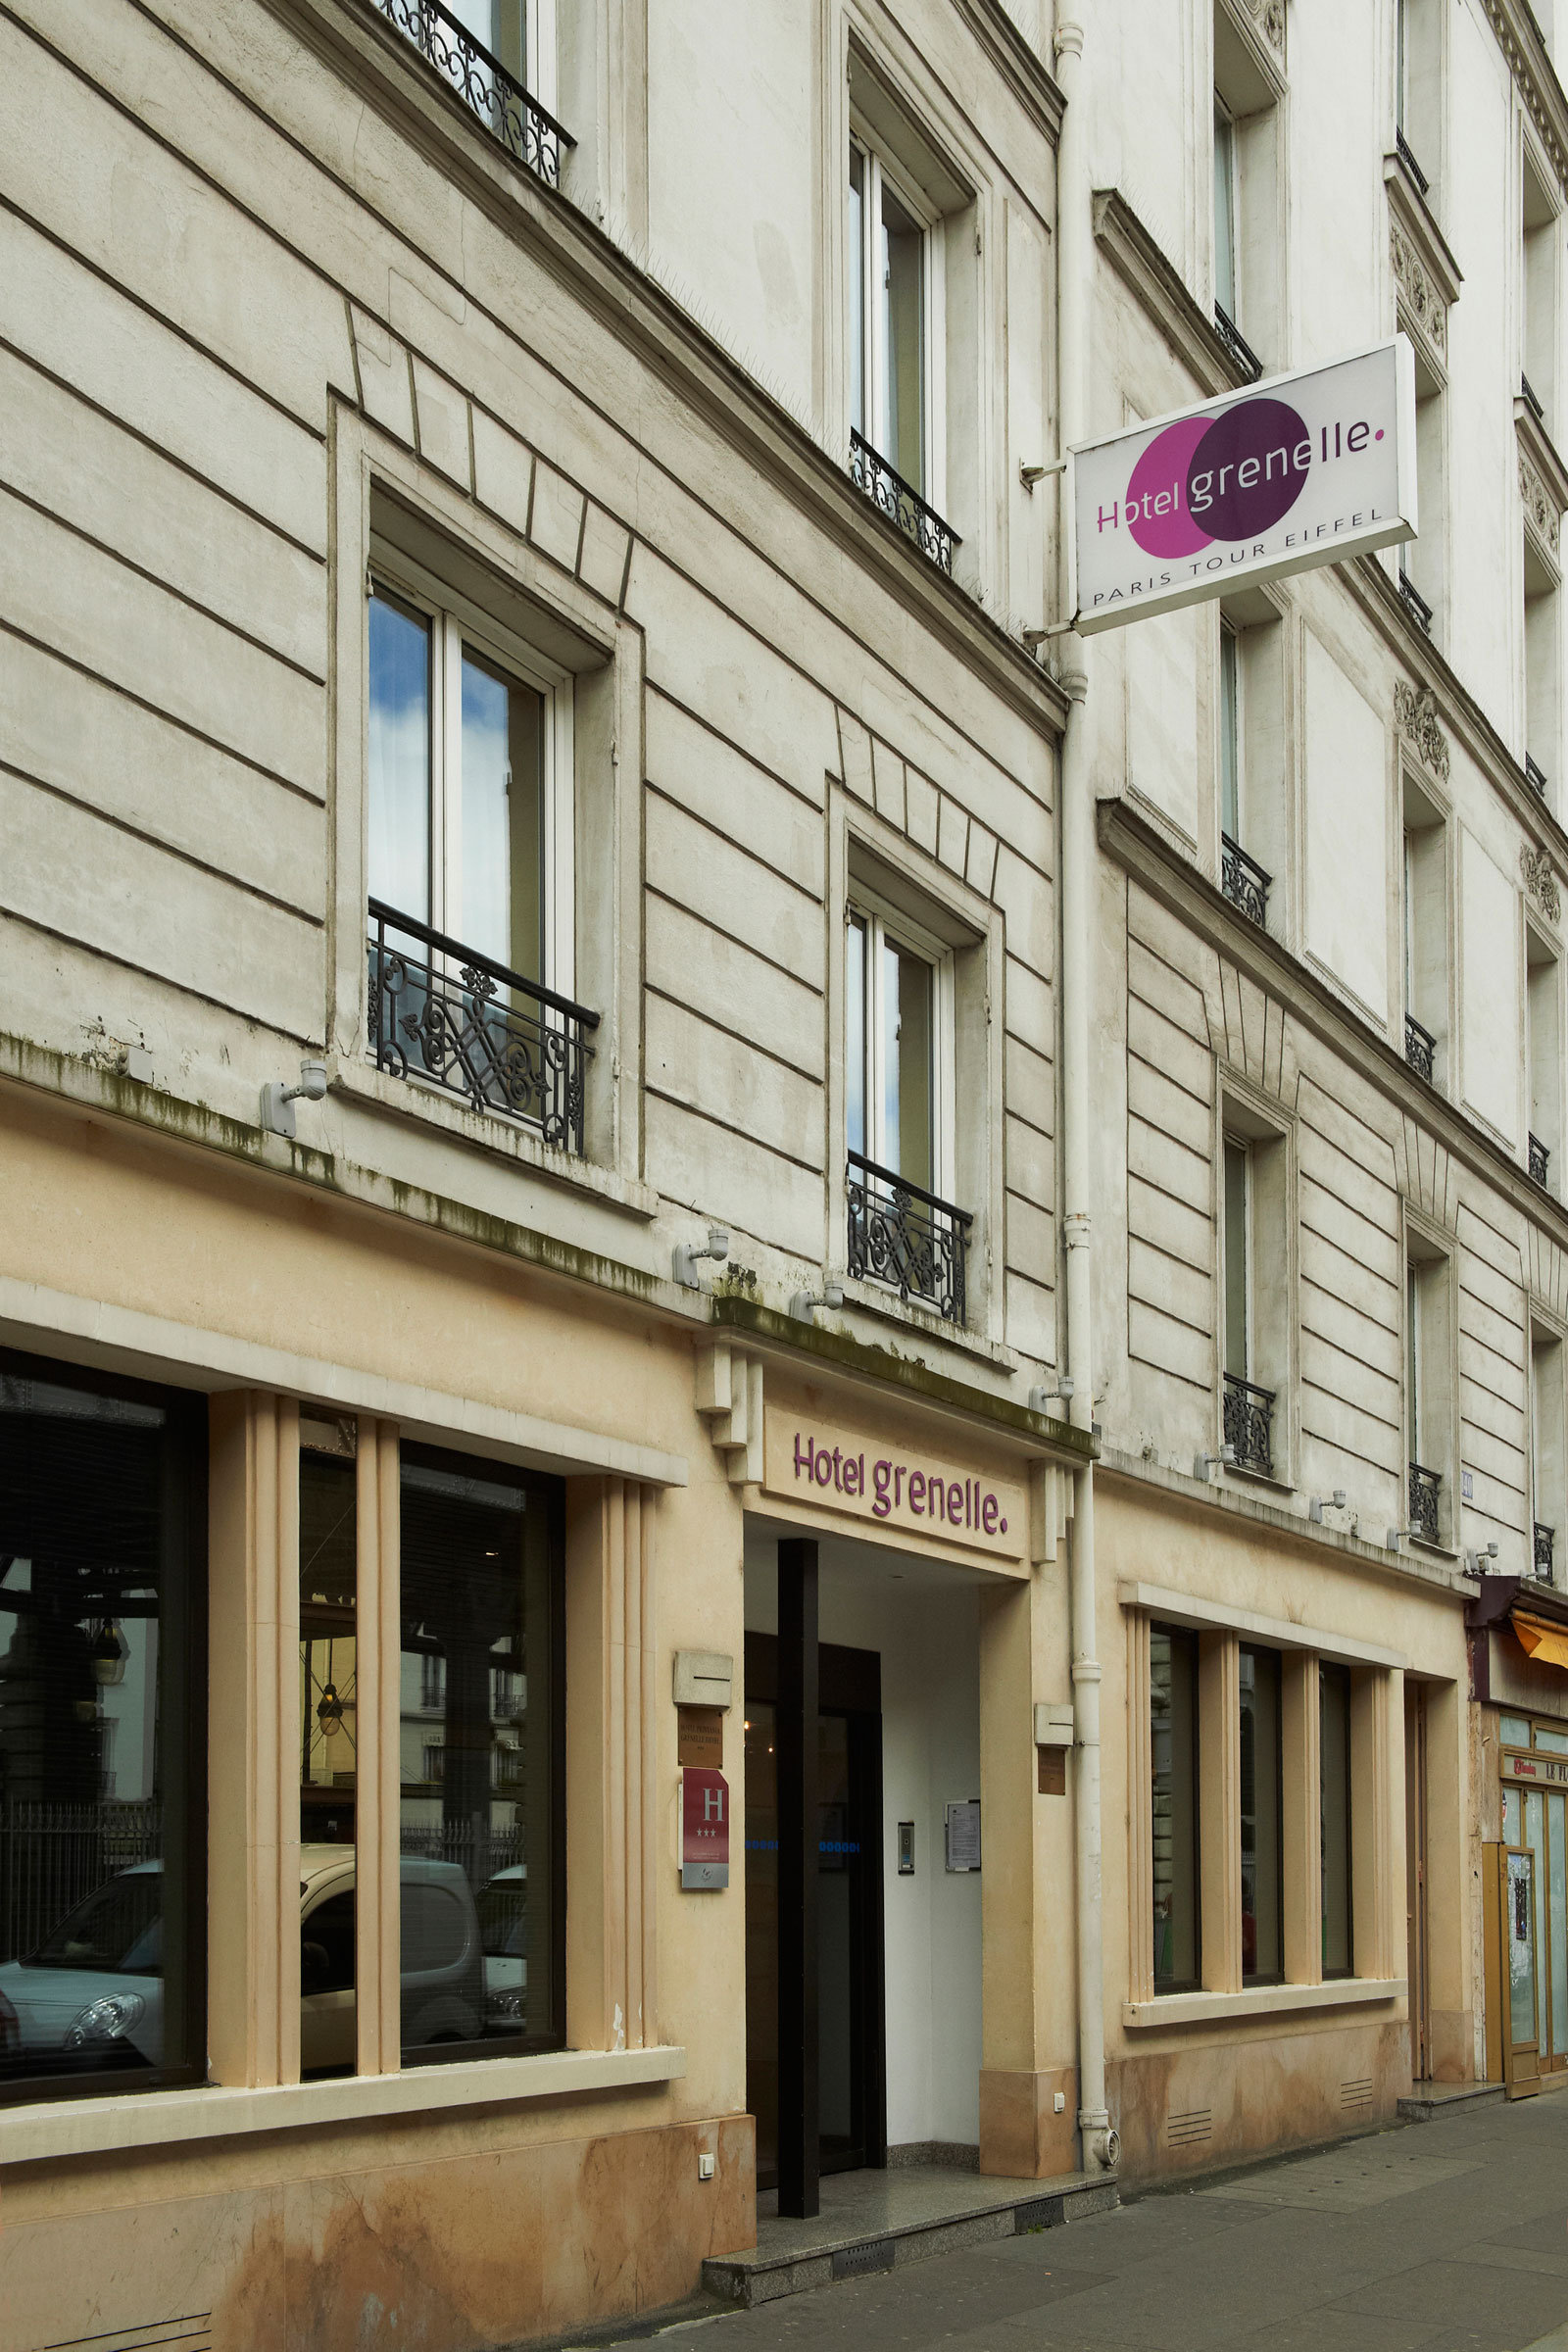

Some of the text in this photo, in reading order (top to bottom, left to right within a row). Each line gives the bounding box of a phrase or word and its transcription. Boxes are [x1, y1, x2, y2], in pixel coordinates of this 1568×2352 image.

[1097, 481, 1179, 533] Hotel
[1093, 509, 1382, 606] PARIS TOUR EIFFEL
[795, 1432, 865, 1496] Hotel
[1545, 1763, 1555, 1780] LE
[1558, 1765, 1568, 1783] FL
[703, 1788, 724, 1822] H
